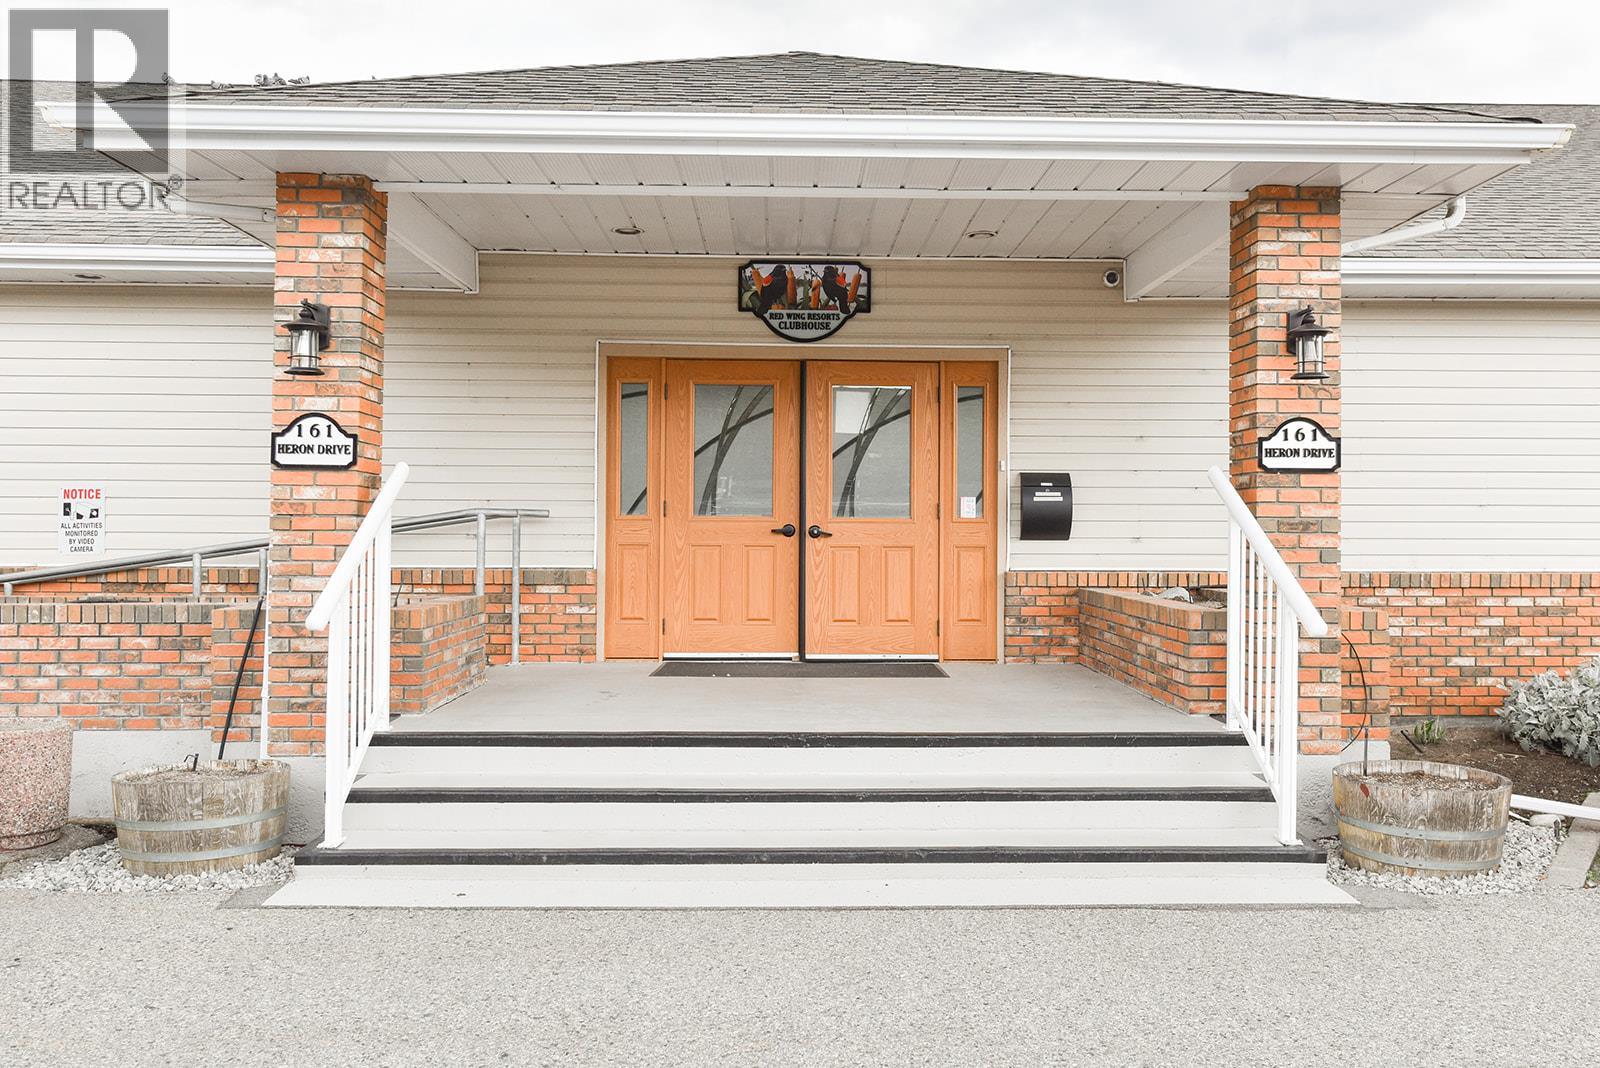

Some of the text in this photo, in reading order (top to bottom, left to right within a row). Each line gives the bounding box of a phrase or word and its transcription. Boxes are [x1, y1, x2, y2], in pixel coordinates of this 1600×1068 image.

[769, 312, 840, 320] RED WING RESORTS
[778, 321, 831, 330] CLUBHOUSE
[296, 423, 333, 438] 161
[1282, 427, 1318, 442] 161
[277, 443, 351, 455] HERON DRIVE
[1264, 448, 1335, 458] HERON DRIVE
[63, 488, 101, 499] NOTICE
